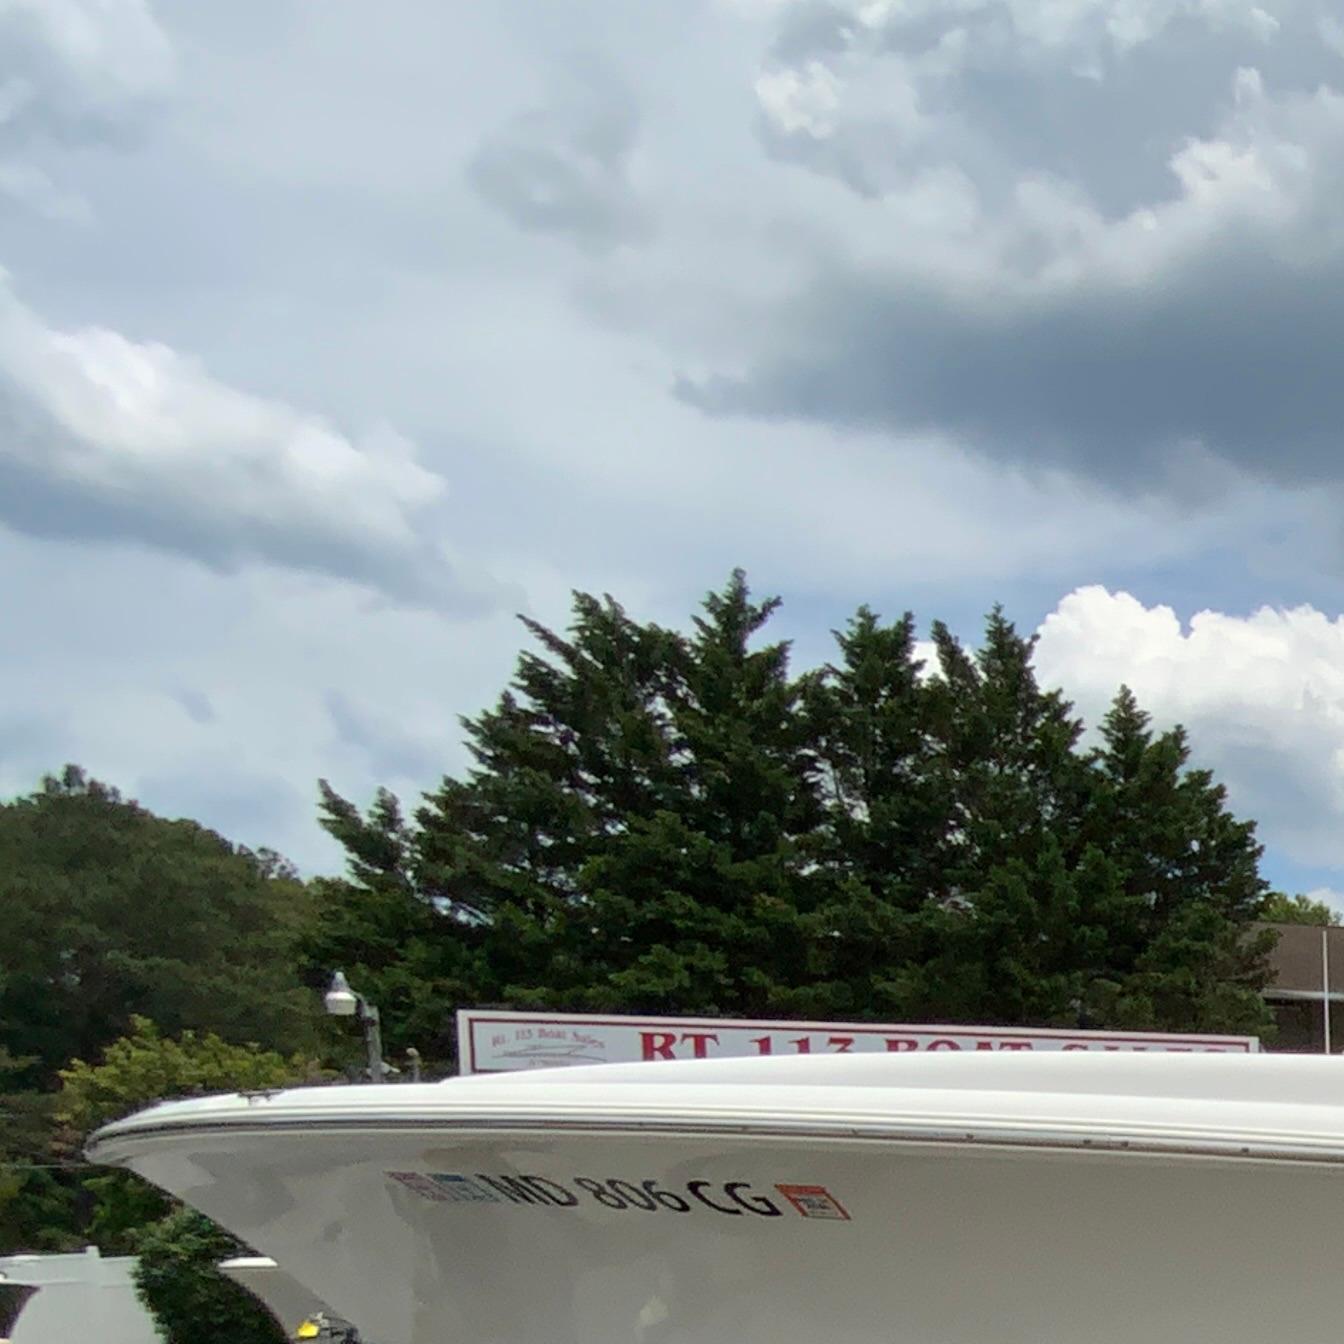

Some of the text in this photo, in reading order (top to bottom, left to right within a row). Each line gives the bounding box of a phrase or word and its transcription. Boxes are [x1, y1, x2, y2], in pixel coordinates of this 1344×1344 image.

[638, 1031, 720, 1061] RT
[474, 1173, 578, 1207] MD
[573, 1176, 690, 1212] 806
[687, 1180, 783, 1216] CG
